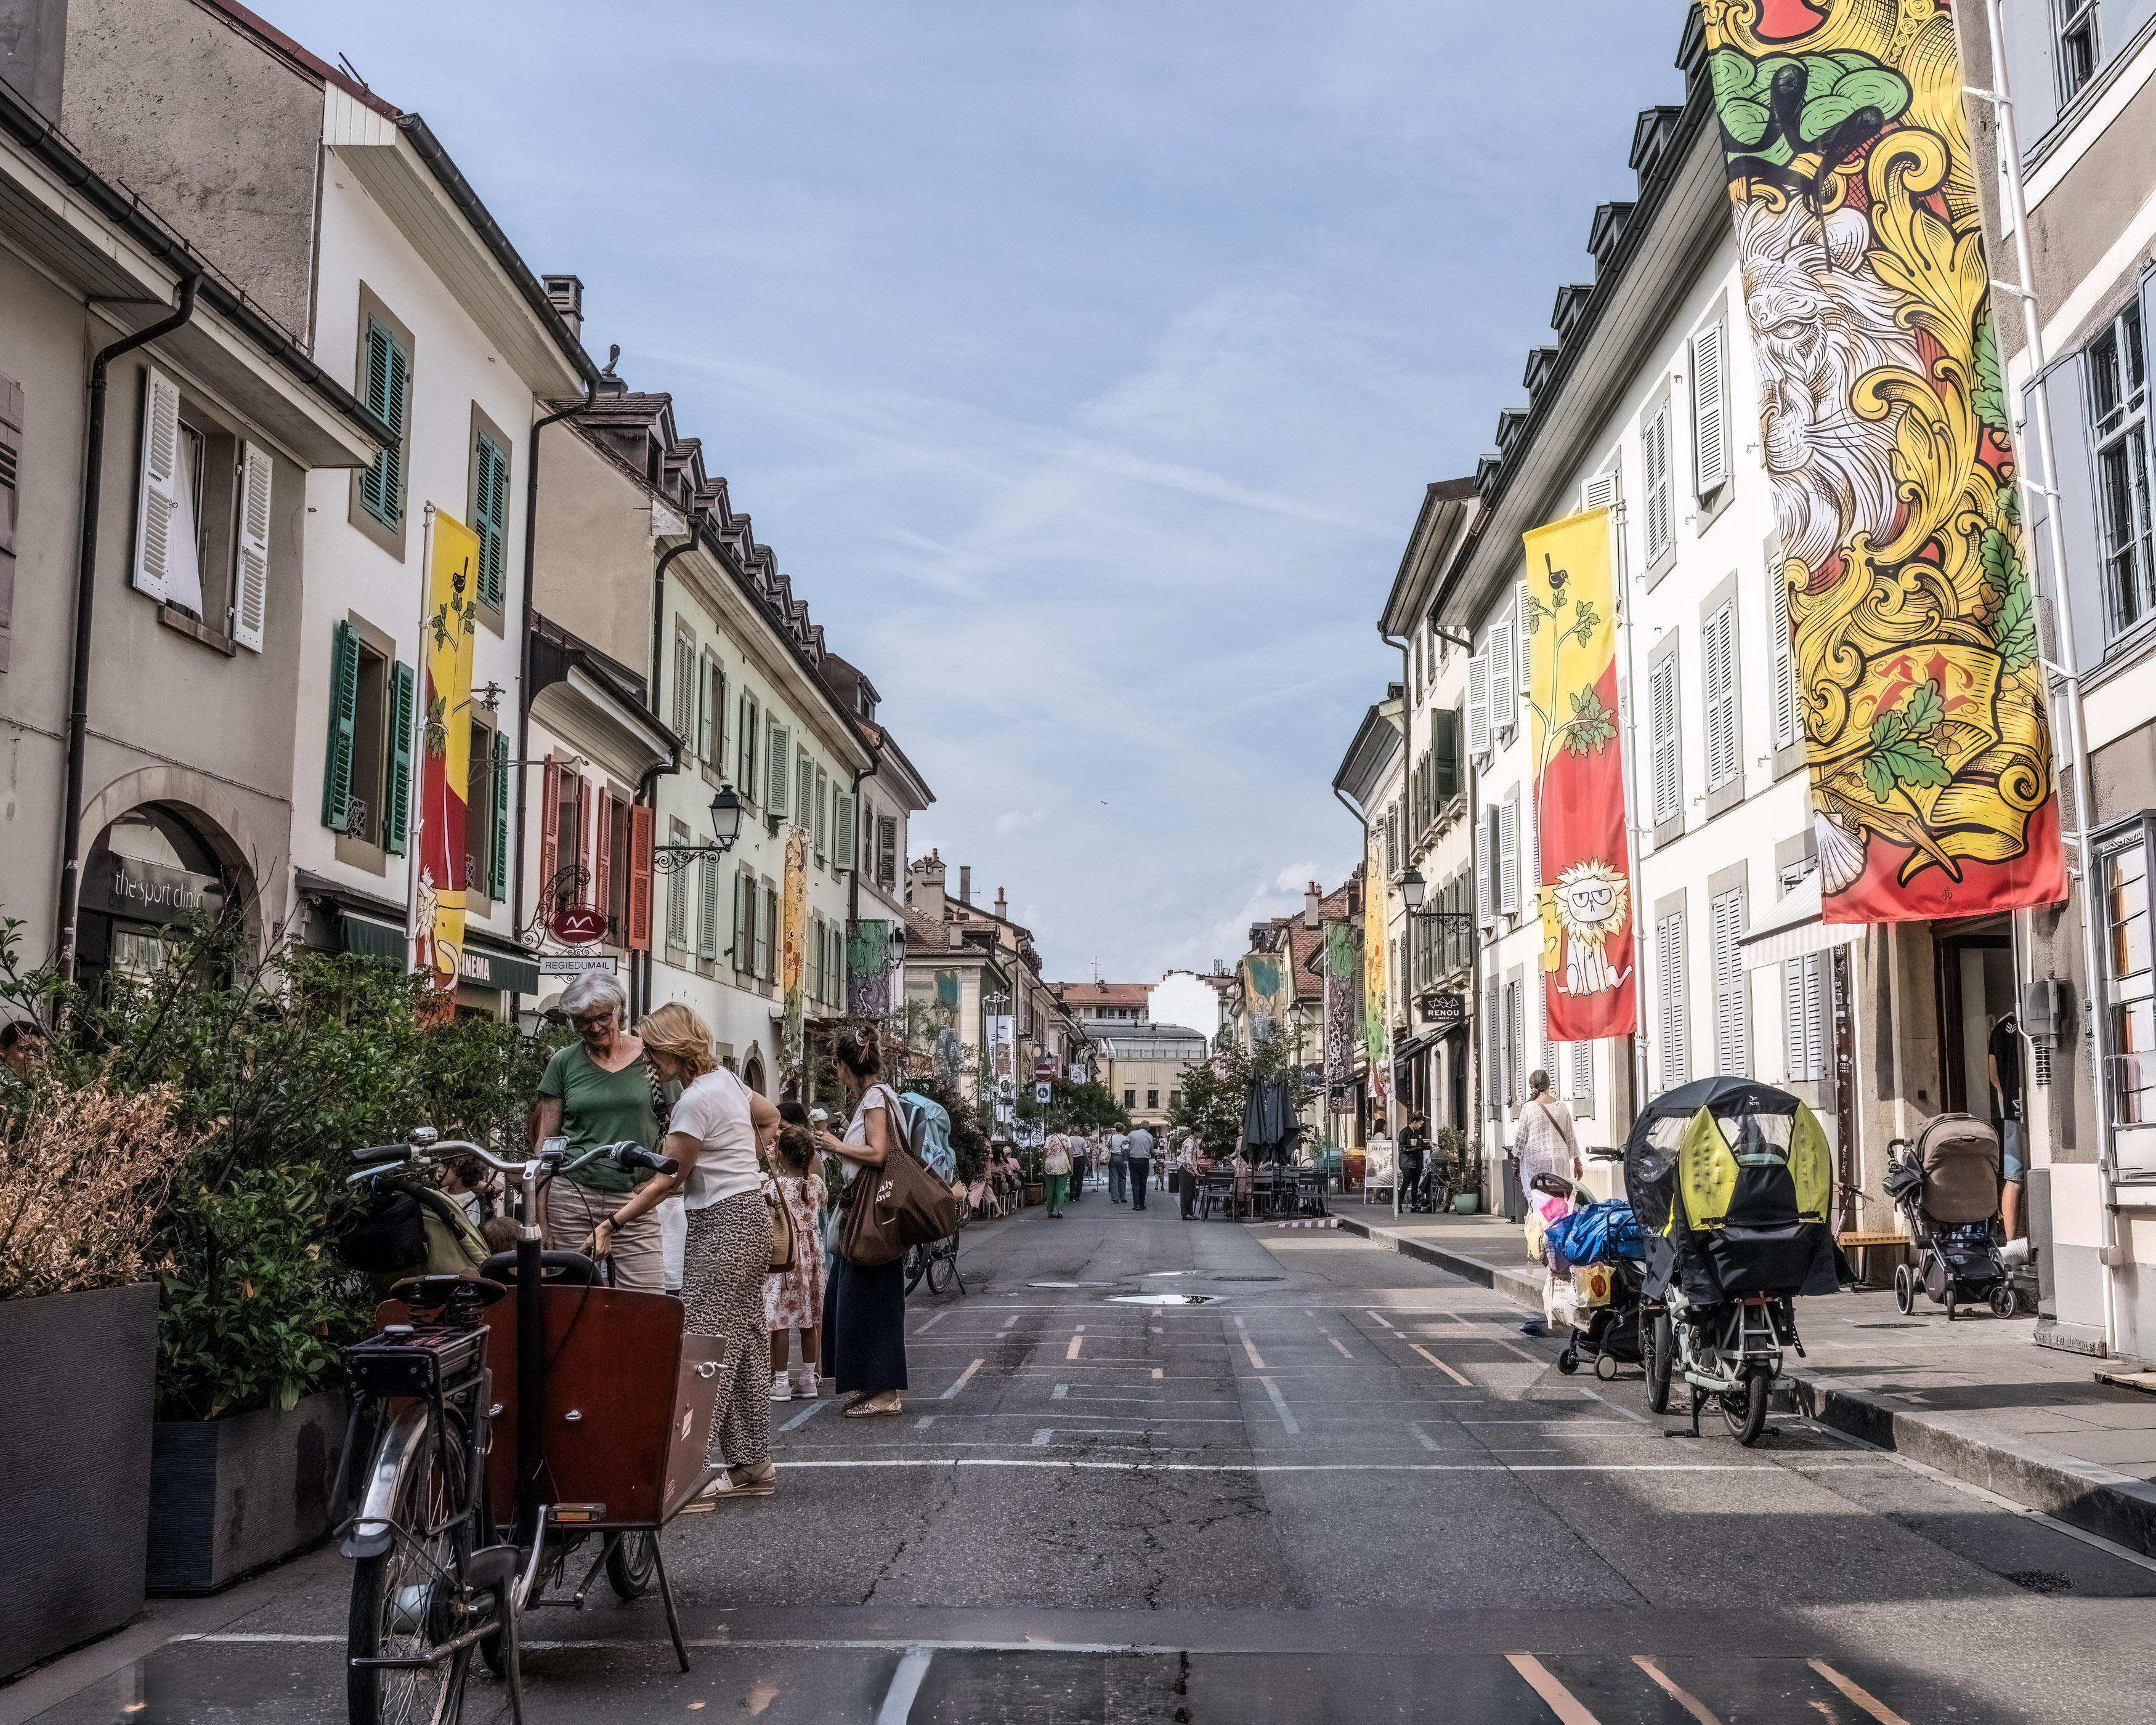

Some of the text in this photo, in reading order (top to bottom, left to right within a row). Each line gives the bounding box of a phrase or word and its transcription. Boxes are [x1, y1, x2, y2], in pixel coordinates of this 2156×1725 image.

[116, 868, 136, 897] the
[139, 881, 171, 907] sport
[875, 1191, 891, 1203] ove
